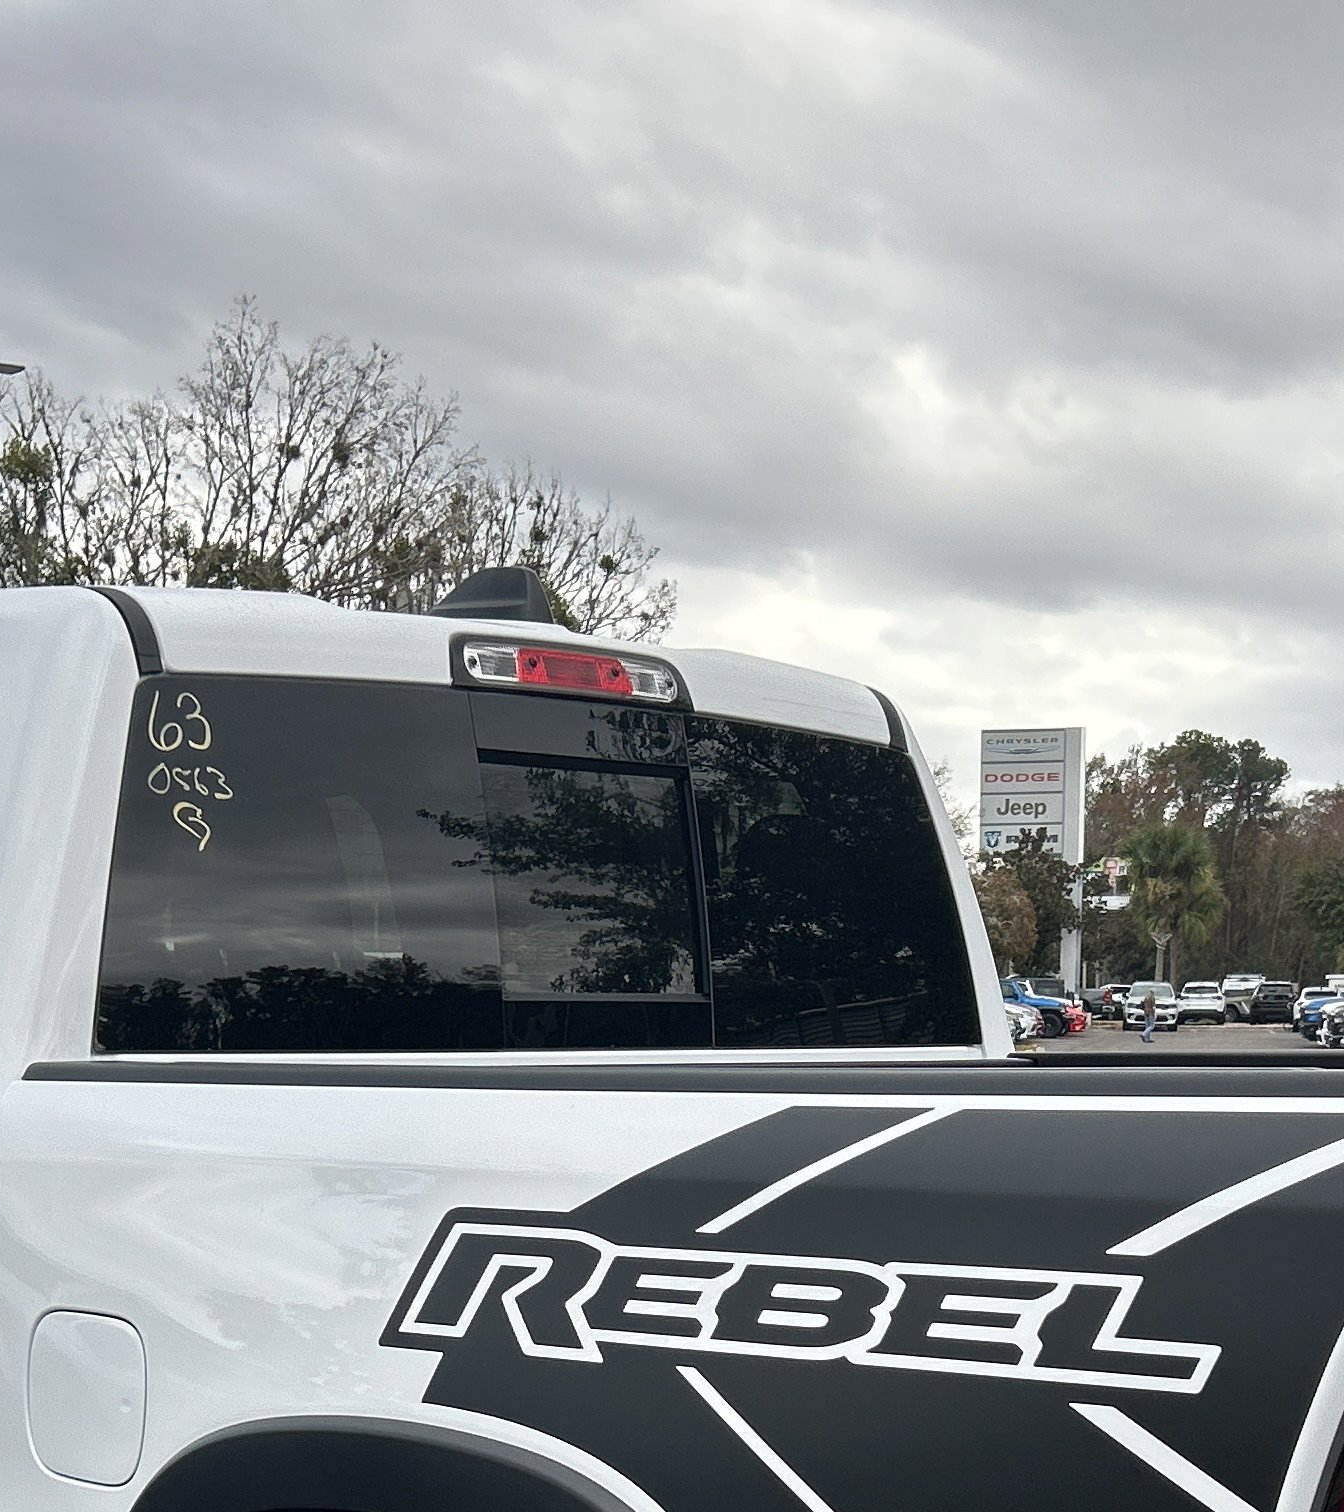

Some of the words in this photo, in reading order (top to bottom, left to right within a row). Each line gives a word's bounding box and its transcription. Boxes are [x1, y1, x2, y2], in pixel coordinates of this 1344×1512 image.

[147, 690, 212, 751] 63
[985, 737, 1059, 745] CHRYSLER
[984, 772, 1060, 783] DODGE
[996, 798, 1047, 819] Jeep
[1006, 834, 1058, 844] RM
[396, 1221, 1223, 1395] REBEL
